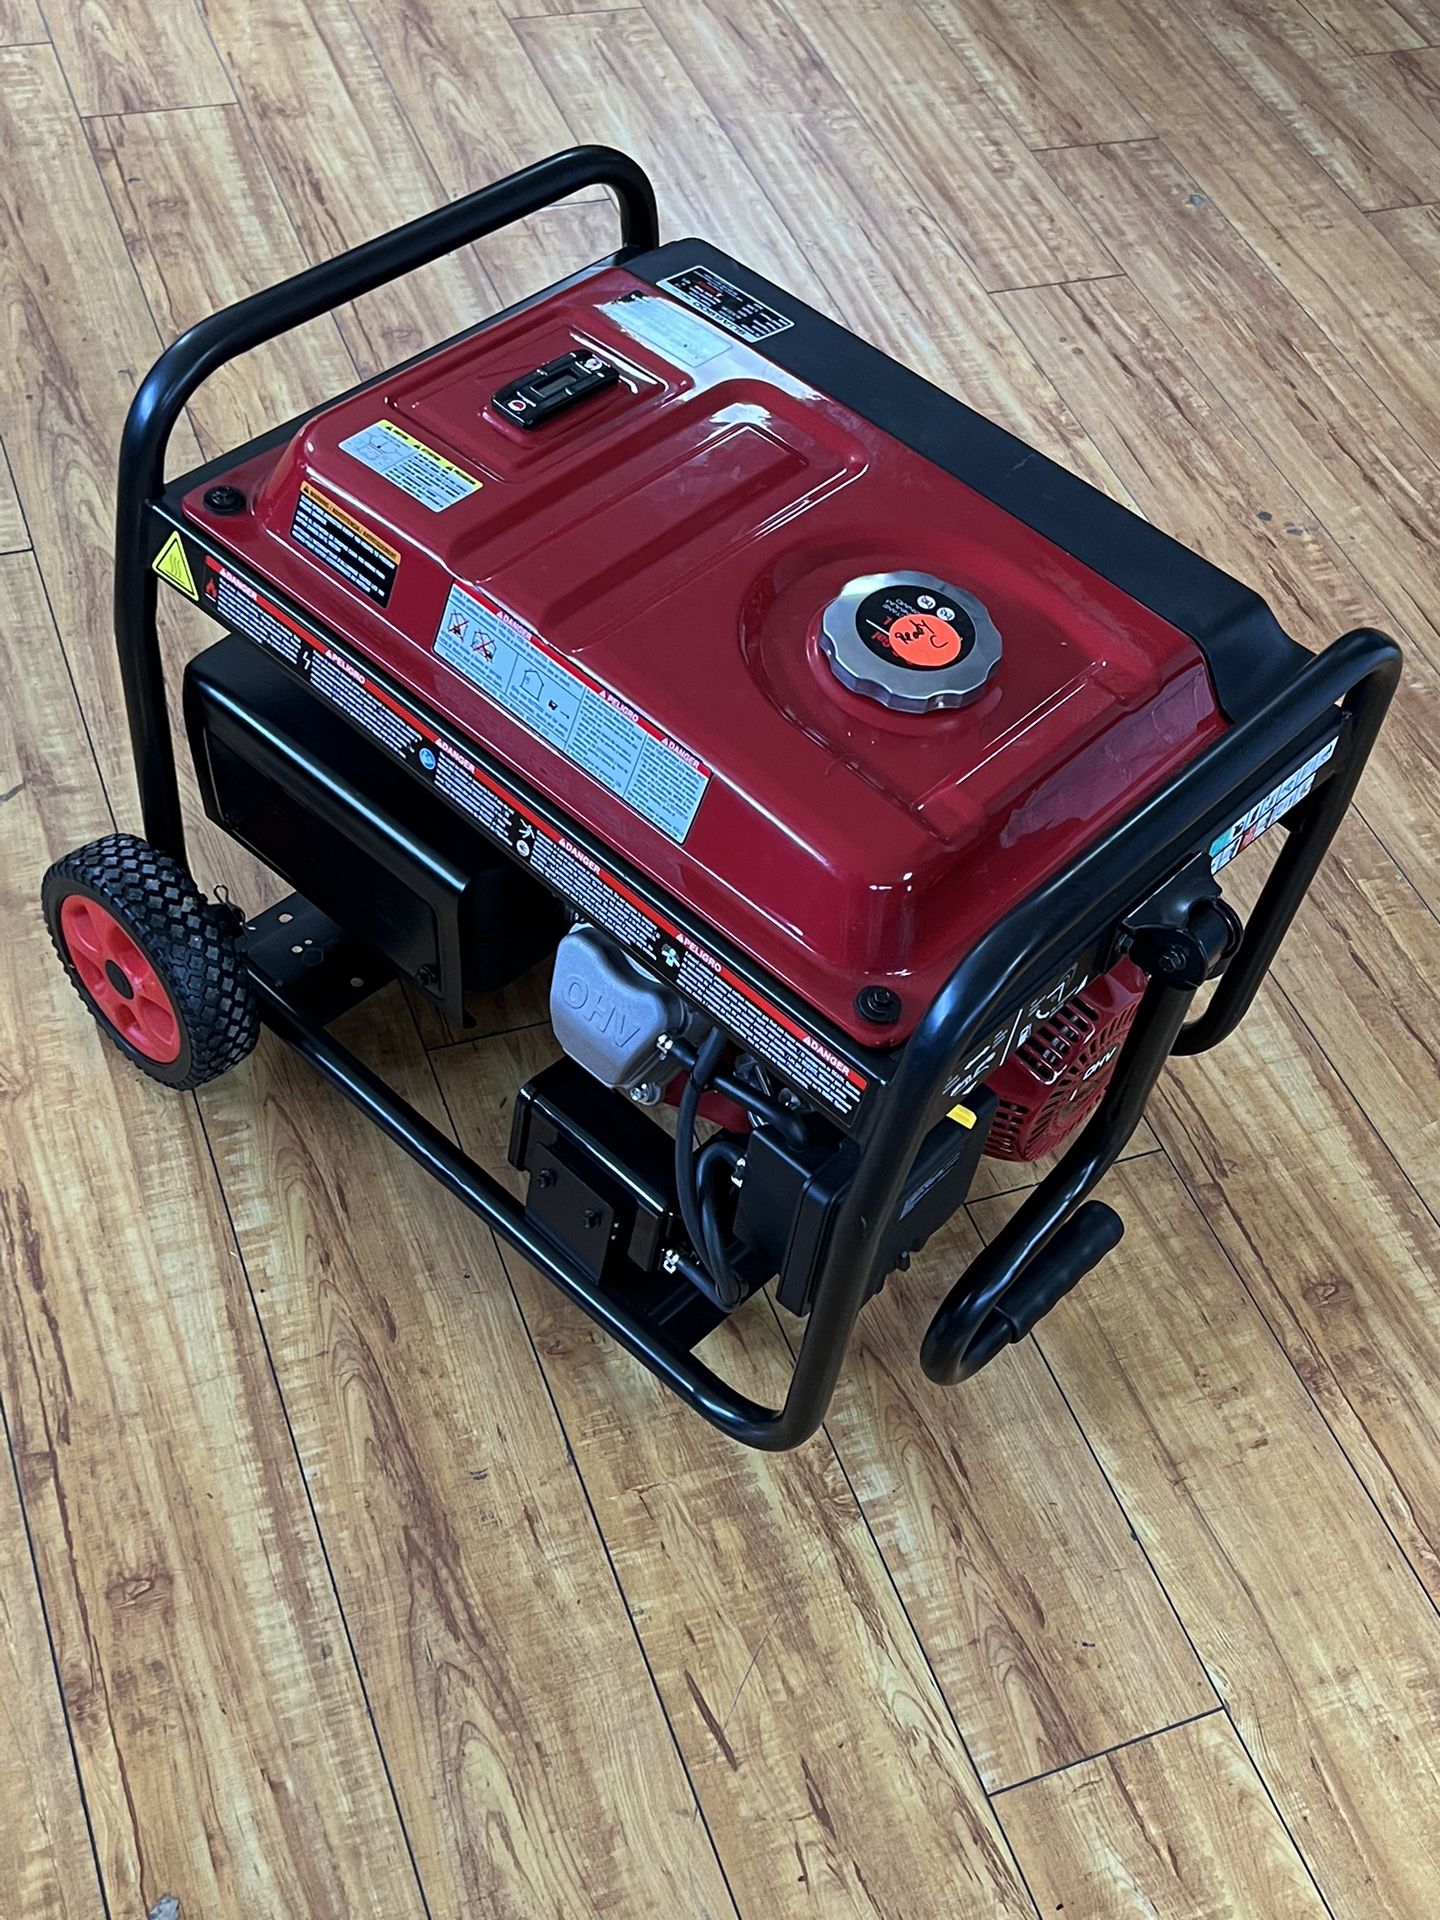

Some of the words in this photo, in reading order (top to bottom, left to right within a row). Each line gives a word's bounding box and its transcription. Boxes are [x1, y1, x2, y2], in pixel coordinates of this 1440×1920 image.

[227, 573, 258, 601] DANGER
[502, 614, 533, 641] DANGER
[332, 653, 366, 684] PELIGRO
[607, 694, 639, 723] PELIGRO
[442, 742, 476, 774] DANGER
[668, 739, 701, 769] DANGER
[565, 841, 601, 875] DANGER
[683, 936, 722, 973] PELIGRO
[562, 976, 641, 1048] OHV
[809, 1040, 850, 1077] DANGER
[1083, 1046, 1117, 1080] OHV
